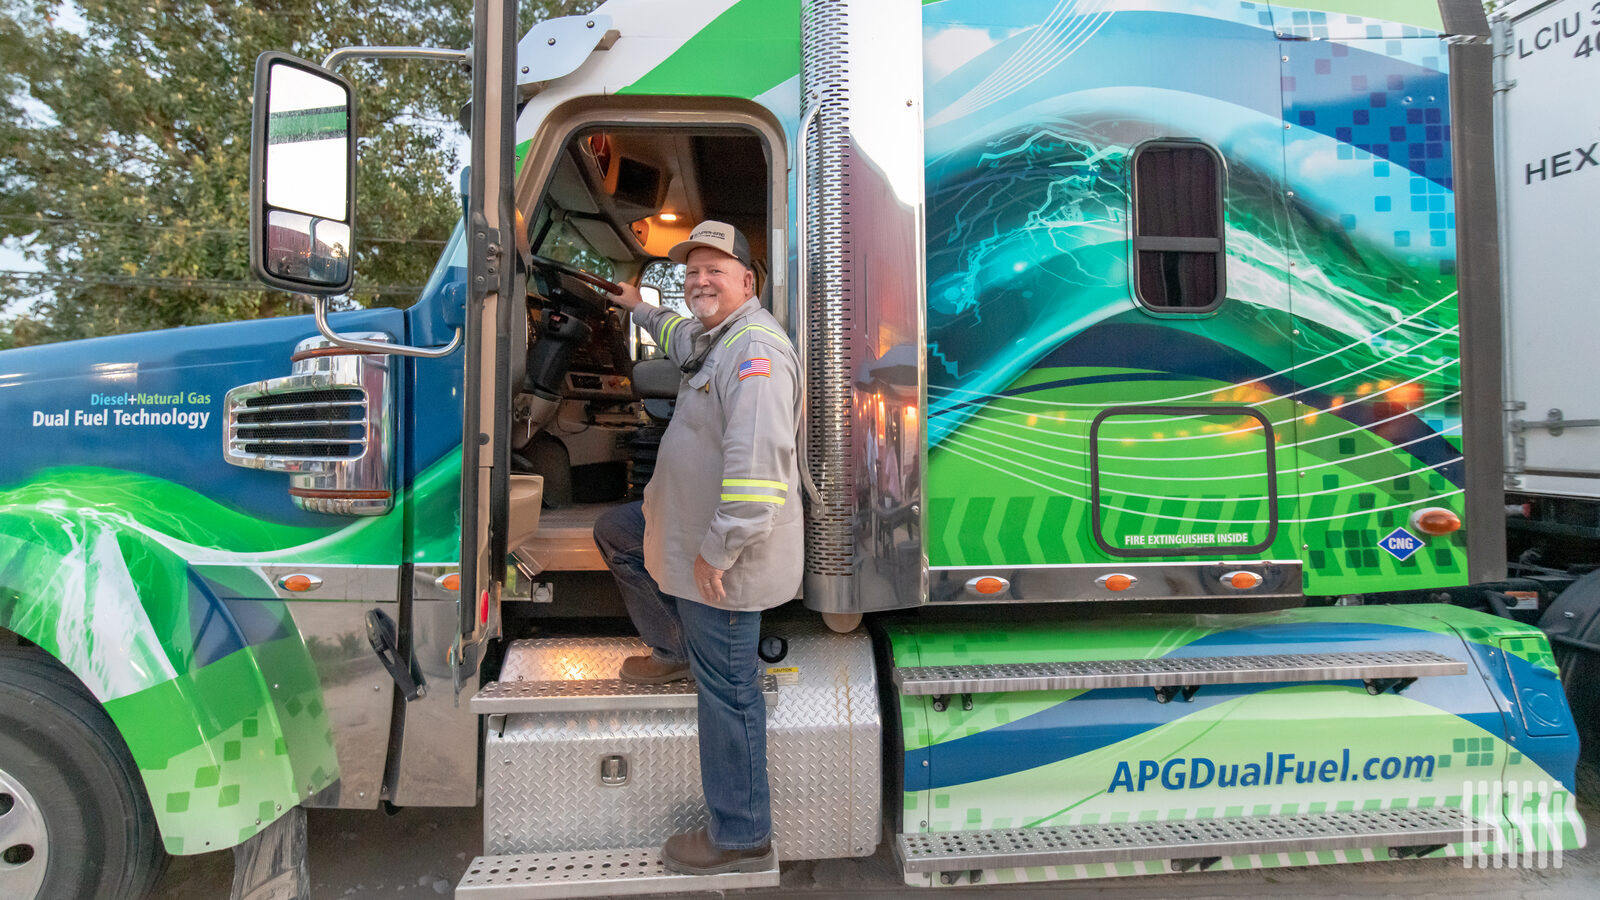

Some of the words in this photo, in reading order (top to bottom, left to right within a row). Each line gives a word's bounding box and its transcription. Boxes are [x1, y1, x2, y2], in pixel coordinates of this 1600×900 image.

[1518, 12, 1580, 59] LCIU
[1525, 142, 1600, 185] HEX
[91, 392, 183, 406] Diesel+Natural
[187, 392, 211, 404] Gas
[33, 410, 69, 427] Dual
[74, 409, 108, 426] Fuel
[113, 408, 210, 429] Technology
[1125, 535, 1145, 545] FIRE
[1147, 534, 1215, 545] EXTINGUISHER
[1217, 533, 1248, 543] INSIDE
[1388, 537, 1413, 550] CNG
[1107, 748, 1435, 793] APGDualFuel.com
